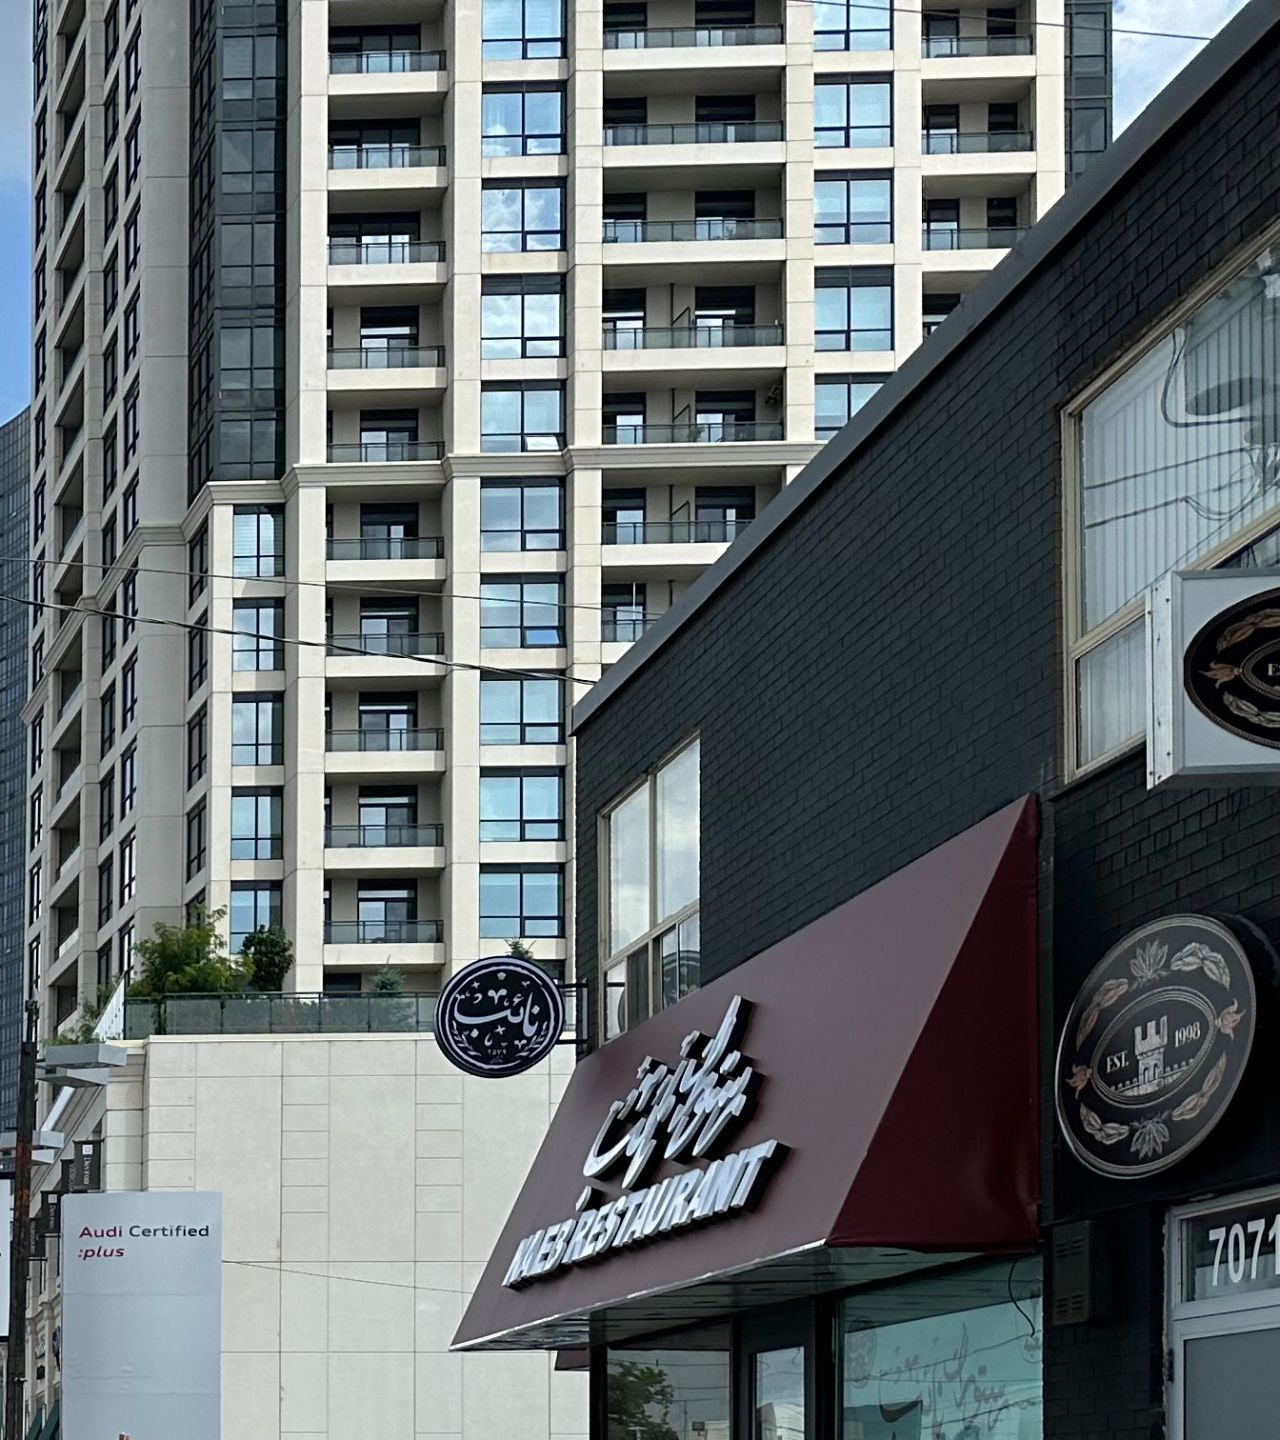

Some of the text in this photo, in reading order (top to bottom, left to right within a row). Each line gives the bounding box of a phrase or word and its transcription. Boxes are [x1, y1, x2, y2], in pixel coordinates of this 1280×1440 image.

[1106, 1021, 1201, 1073] EST. 1998
[561, 1138, 778, 1265] RESTAURANT
[77, 1245, 125, 1260] :plus
[79, 1224, 210, 1239] Audi Certified
[1208, 1213, 1280, 1287] 7071
